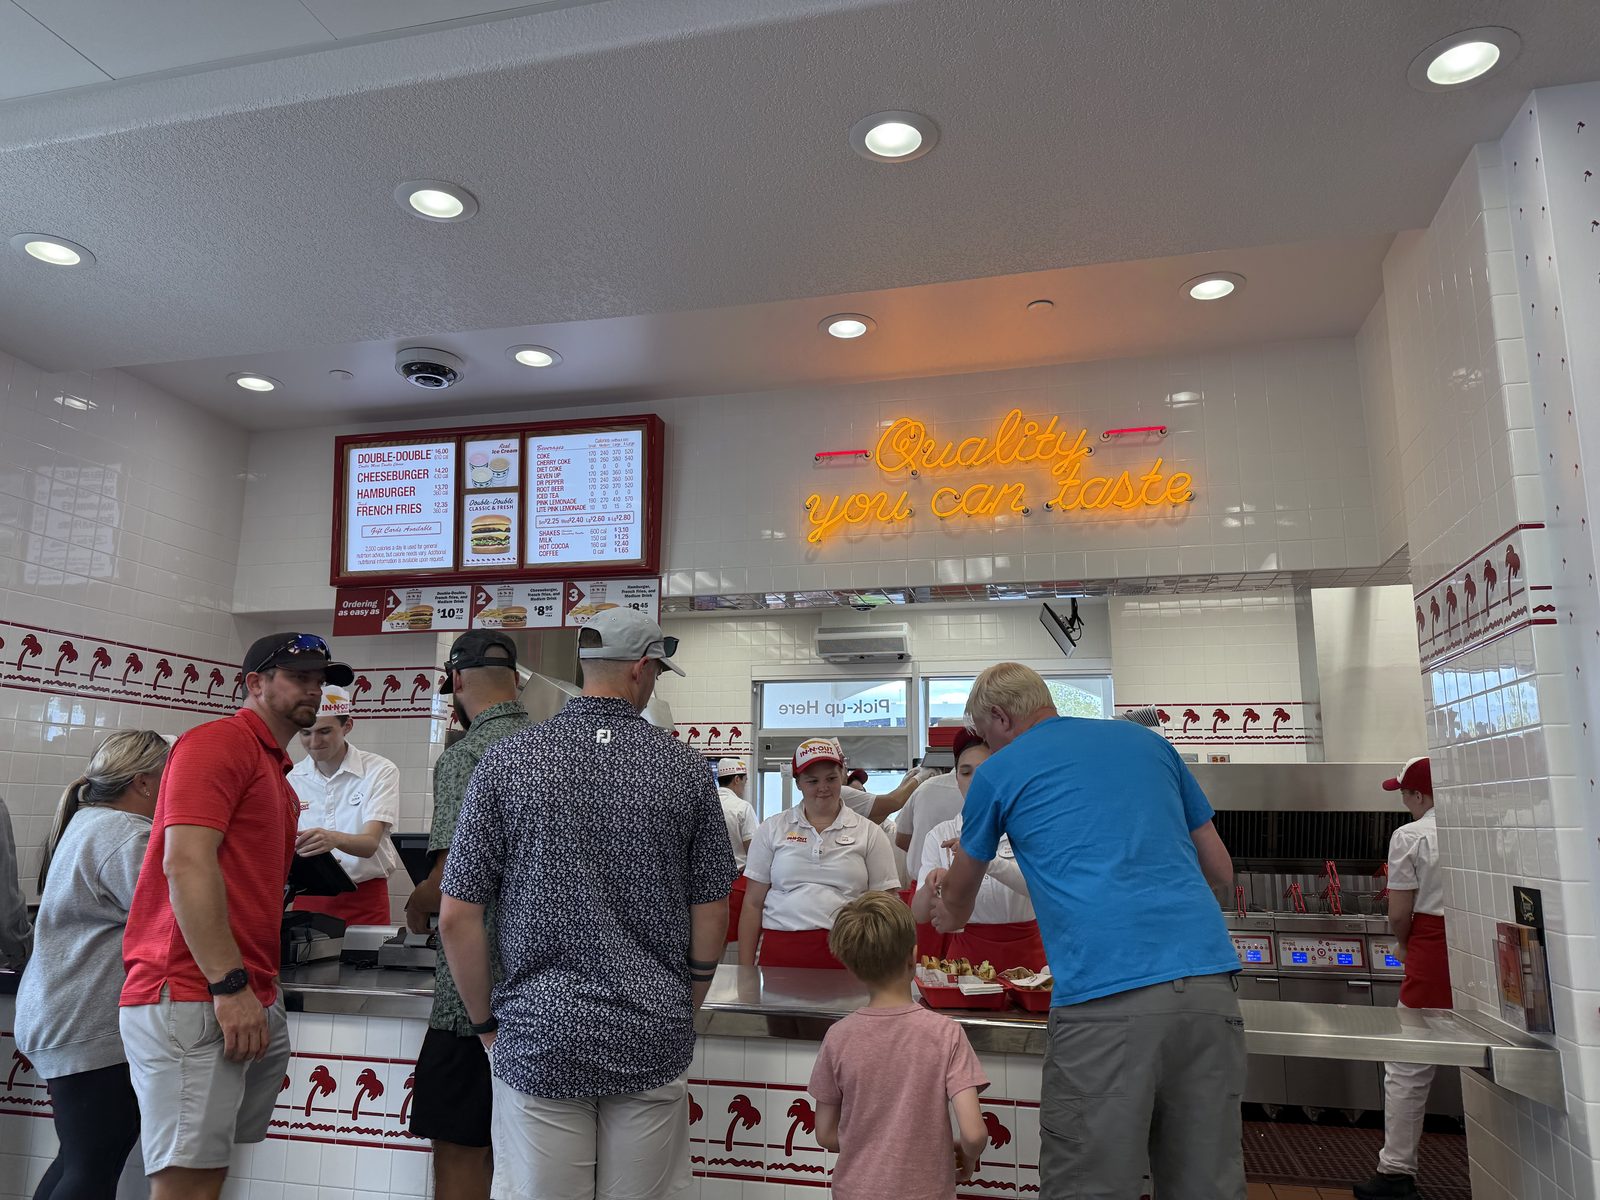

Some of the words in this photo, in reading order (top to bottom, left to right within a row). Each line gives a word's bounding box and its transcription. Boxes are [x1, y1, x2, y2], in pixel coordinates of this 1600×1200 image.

[875, 408, 1089, 475] Quality
[358, 450, 431, 464] DOUBLE-DOUBLE
[358, 469, 429, 483] CHEESEBURGER
[357, 486, 416, 499] HAMBURGER
[469, 498, 513, 506] Double-Double
[806, 491, 911, 544] you
[931, 480, 1027, 519] can
[1046, 457, 1194, 511] taste
[357, 505, 393, 516] FRENCH
[396, 503, 422, 514] FRIES
[476, 592, 487, 605] 2
[568, 588, 579, 601] 3
[342, 600, 378, 609] Ordering
[386, 596, 395, 608] 1
[350, 609, 369, 617] easy
[799, 746, 833, 758] IN-N-OUT
